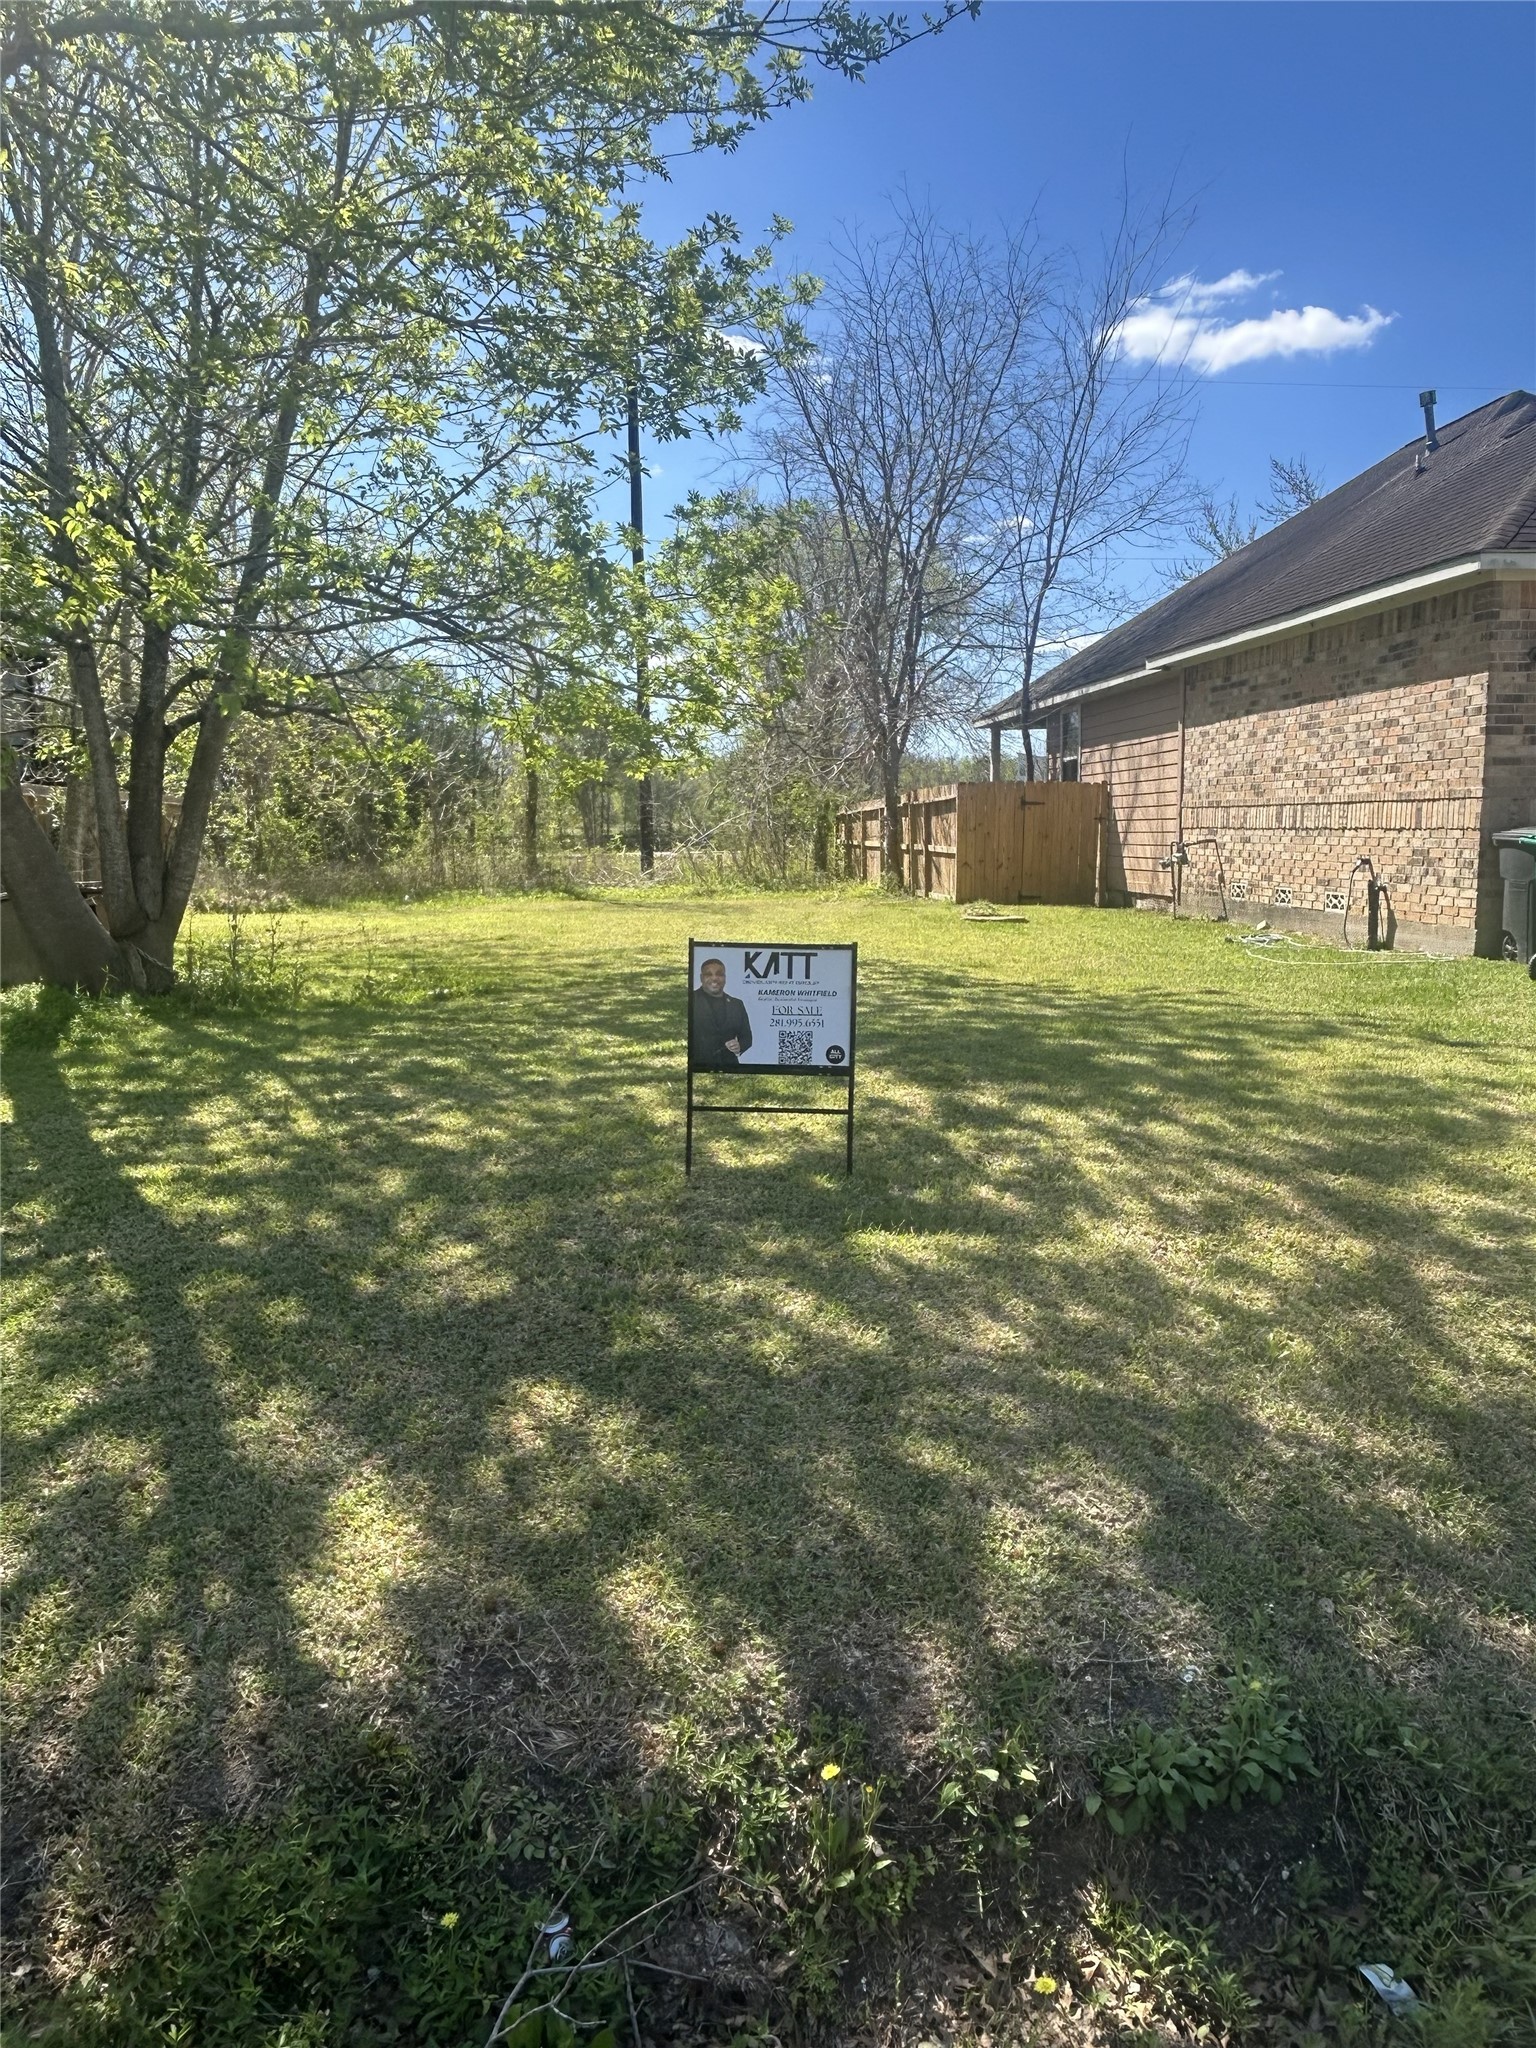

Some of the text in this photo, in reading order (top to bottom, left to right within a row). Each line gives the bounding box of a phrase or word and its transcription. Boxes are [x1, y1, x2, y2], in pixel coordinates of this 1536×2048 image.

[744, 951, 818, 980] KATT
[757, 989, 838, 998] KAMERON WHITFIELD
[772, 1005, 823, 1016] FOR SALE
